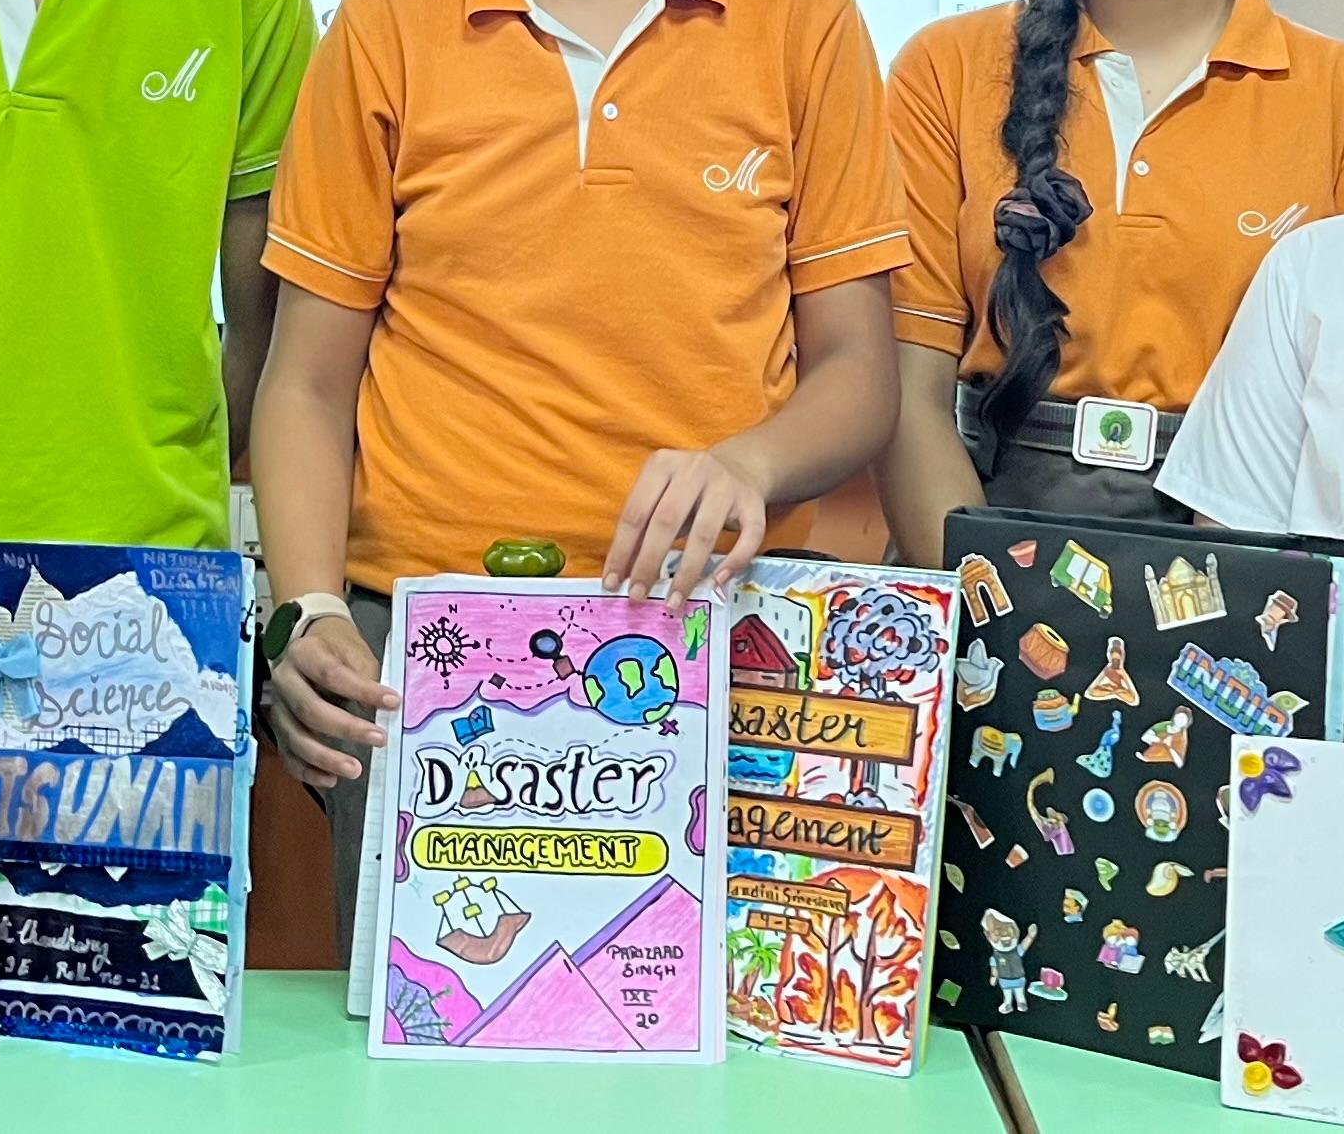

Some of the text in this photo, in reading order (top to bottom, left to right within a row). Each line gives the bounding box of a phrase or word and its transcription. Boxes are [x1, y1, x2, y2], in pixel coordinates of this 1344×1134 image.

[34, 599, 169, 663] Social
[29, 674, 193, 732] Science
[1175, 646, 1289, 738] INDIA
[428, 831, 641, 869] MANAGEMENT
[622, 961, 677, 981] SINGH
